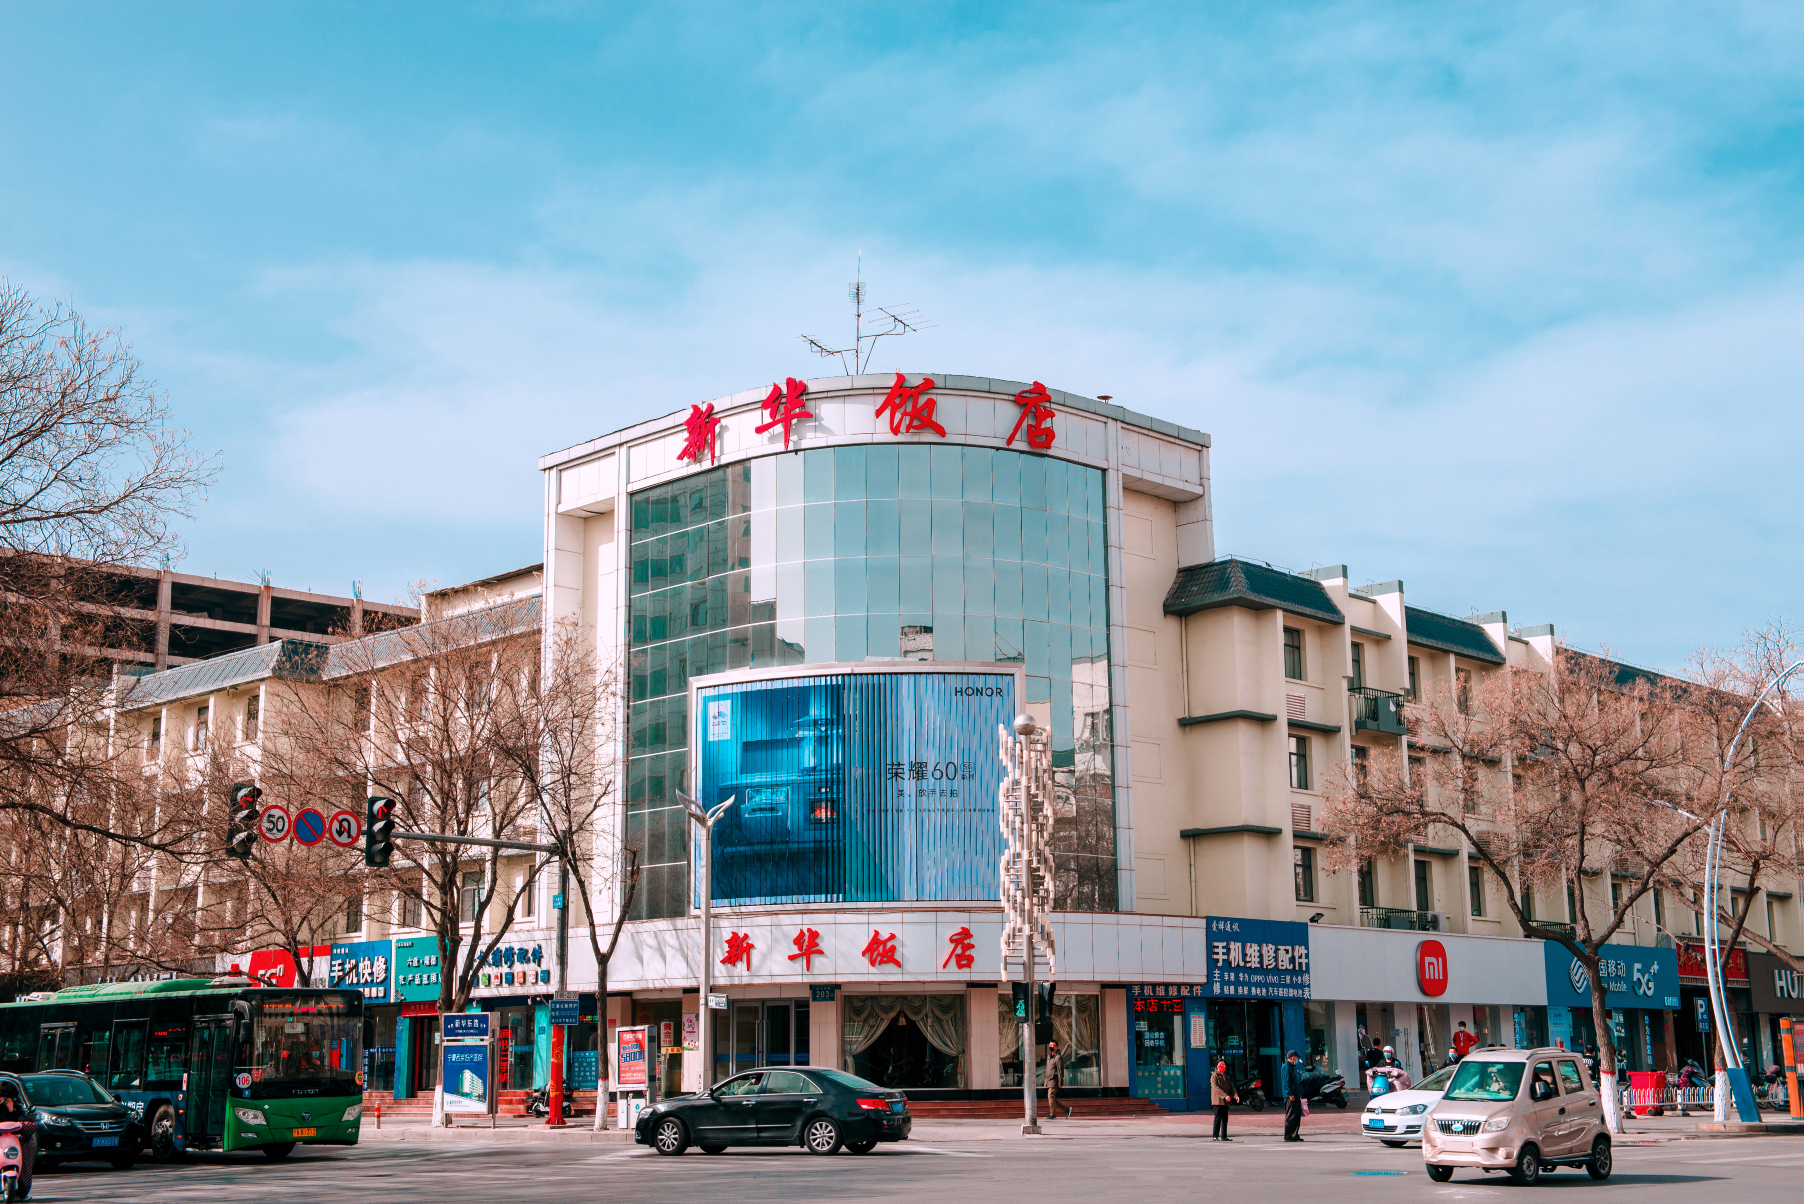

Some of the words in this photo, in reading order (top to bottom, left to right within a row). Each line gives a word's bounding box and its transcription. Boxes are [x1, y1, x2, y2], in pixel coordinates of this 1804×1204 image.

[677, 373, 1057, 466] 新华饭店
[955, 687, 1003, 697] HONOR
[887, 761, 957, 782] 荣耀60
[266, 814, 286, 833] 50
[720, 926, 976, 972] 新华饭店
[1212, 941, 1309, 971] 手机维修配件
[329, 955, 388, 985] 手机快修
[1599, 959, 1626, 978] 国移动
[1251, 974, 1265, 983] OPPO
[1280, 975, 1291, 985] 三星
[1292, 975, 1302, 985] 小米
[1609, 981, 1627, 992] Mobile
[1773, 969, 1804, 999] HU
[1131, 985, 1203, 996] 手机维修配件
[1697, 999, 1706, 1020] P
[454, 1019, 479, 1028] 新华东路
[237, 1076, 251, 1086] 106
